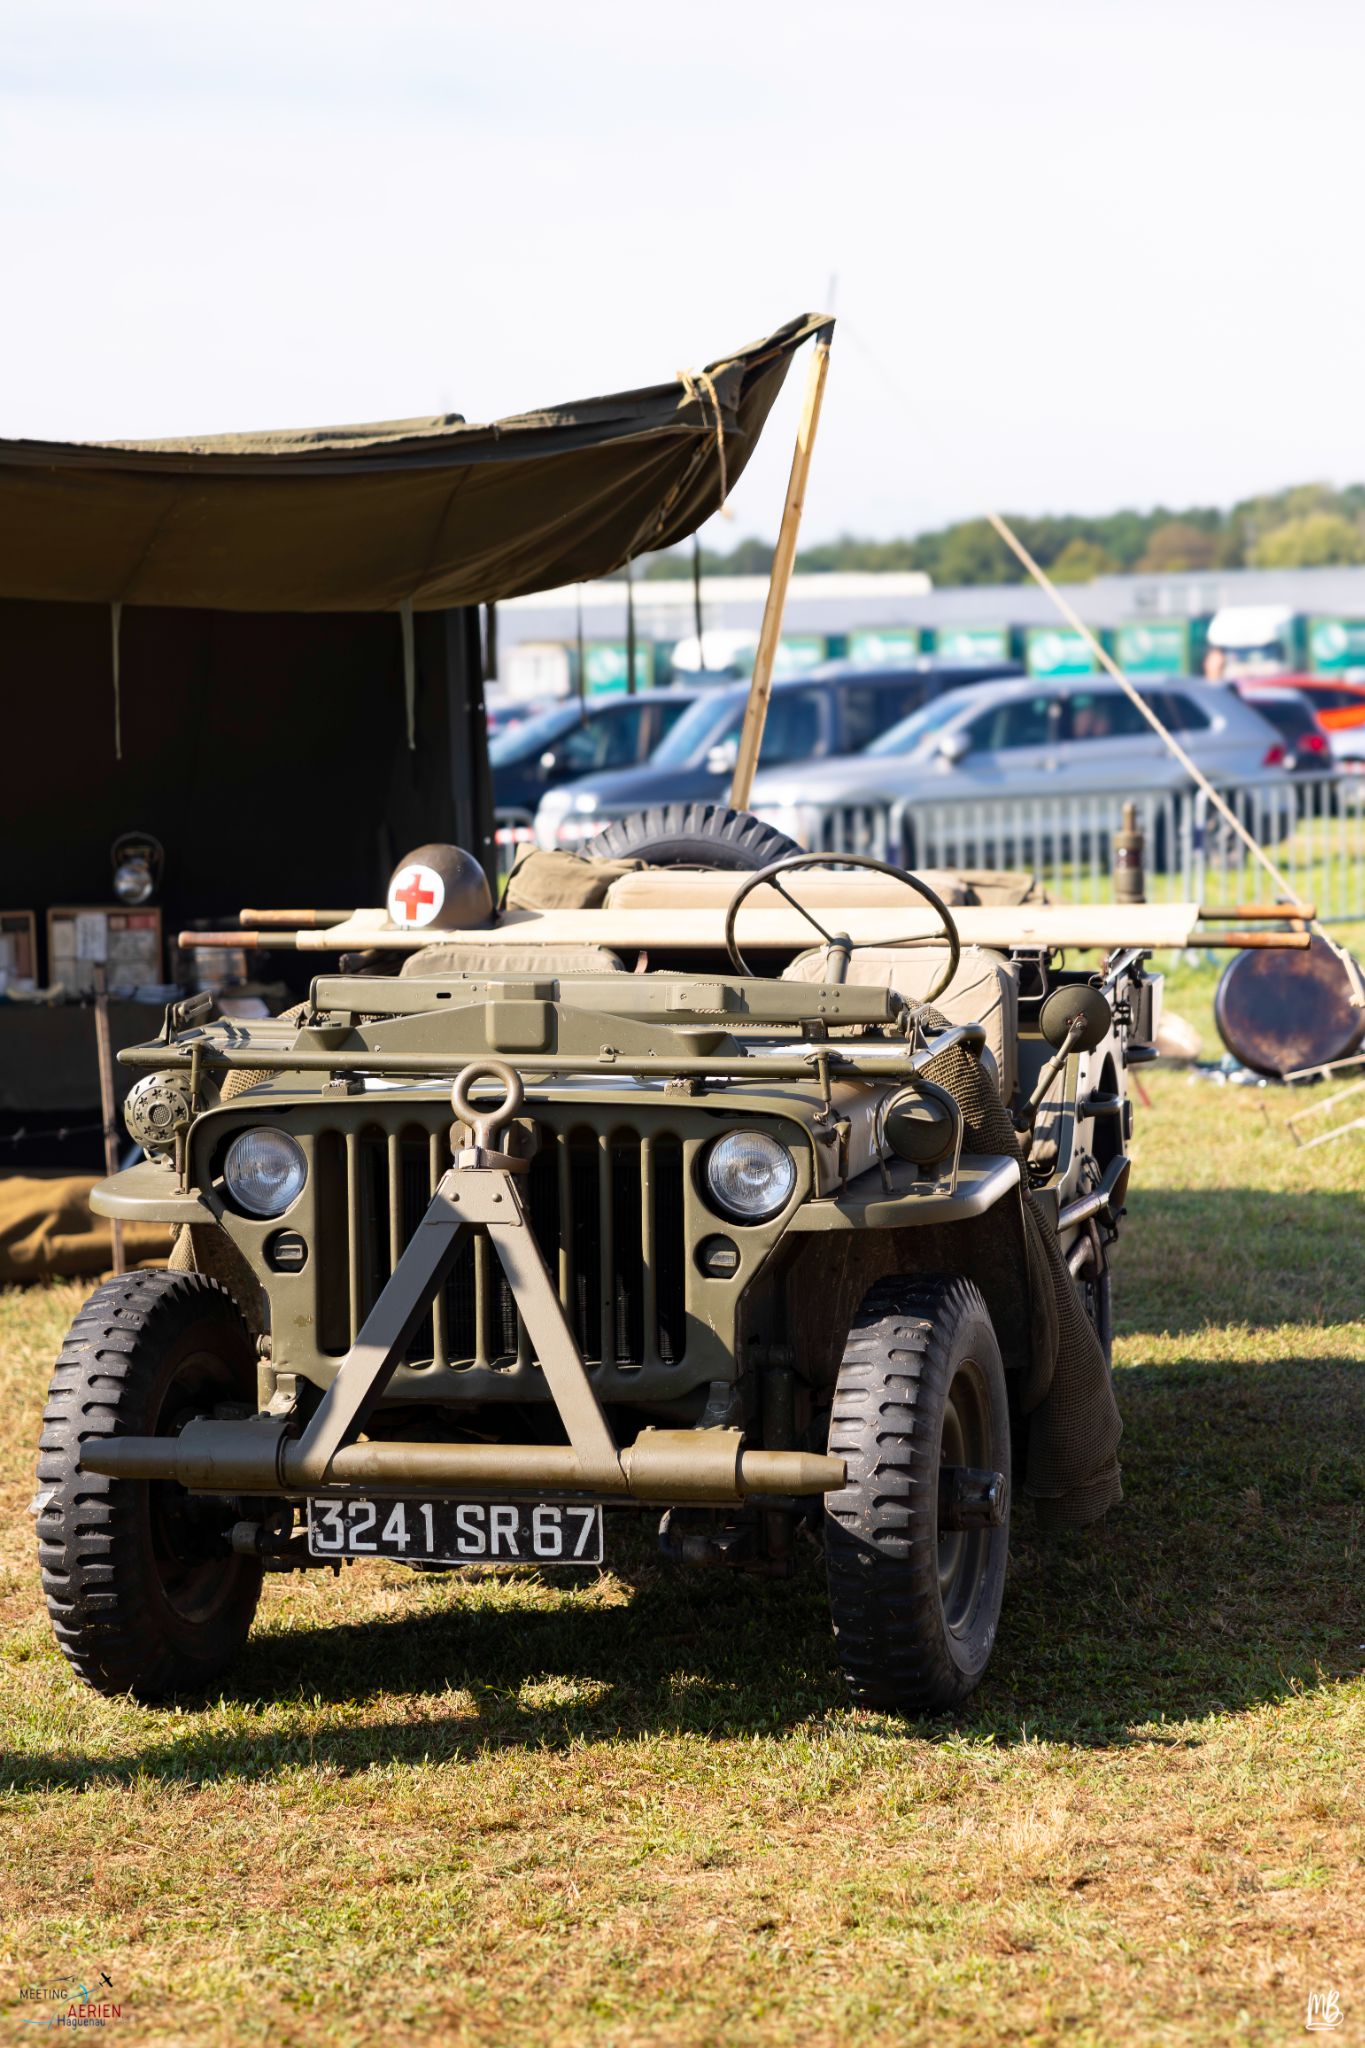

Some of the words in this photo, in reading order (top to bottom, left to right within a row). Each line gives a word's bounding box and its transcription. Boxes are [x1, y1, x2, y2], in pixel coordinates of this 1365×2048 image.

[314, 1500, 434, 1552] 3241
[456, 1505, 519, 1555] SR
[532, 1506, 595, 1557] 67
